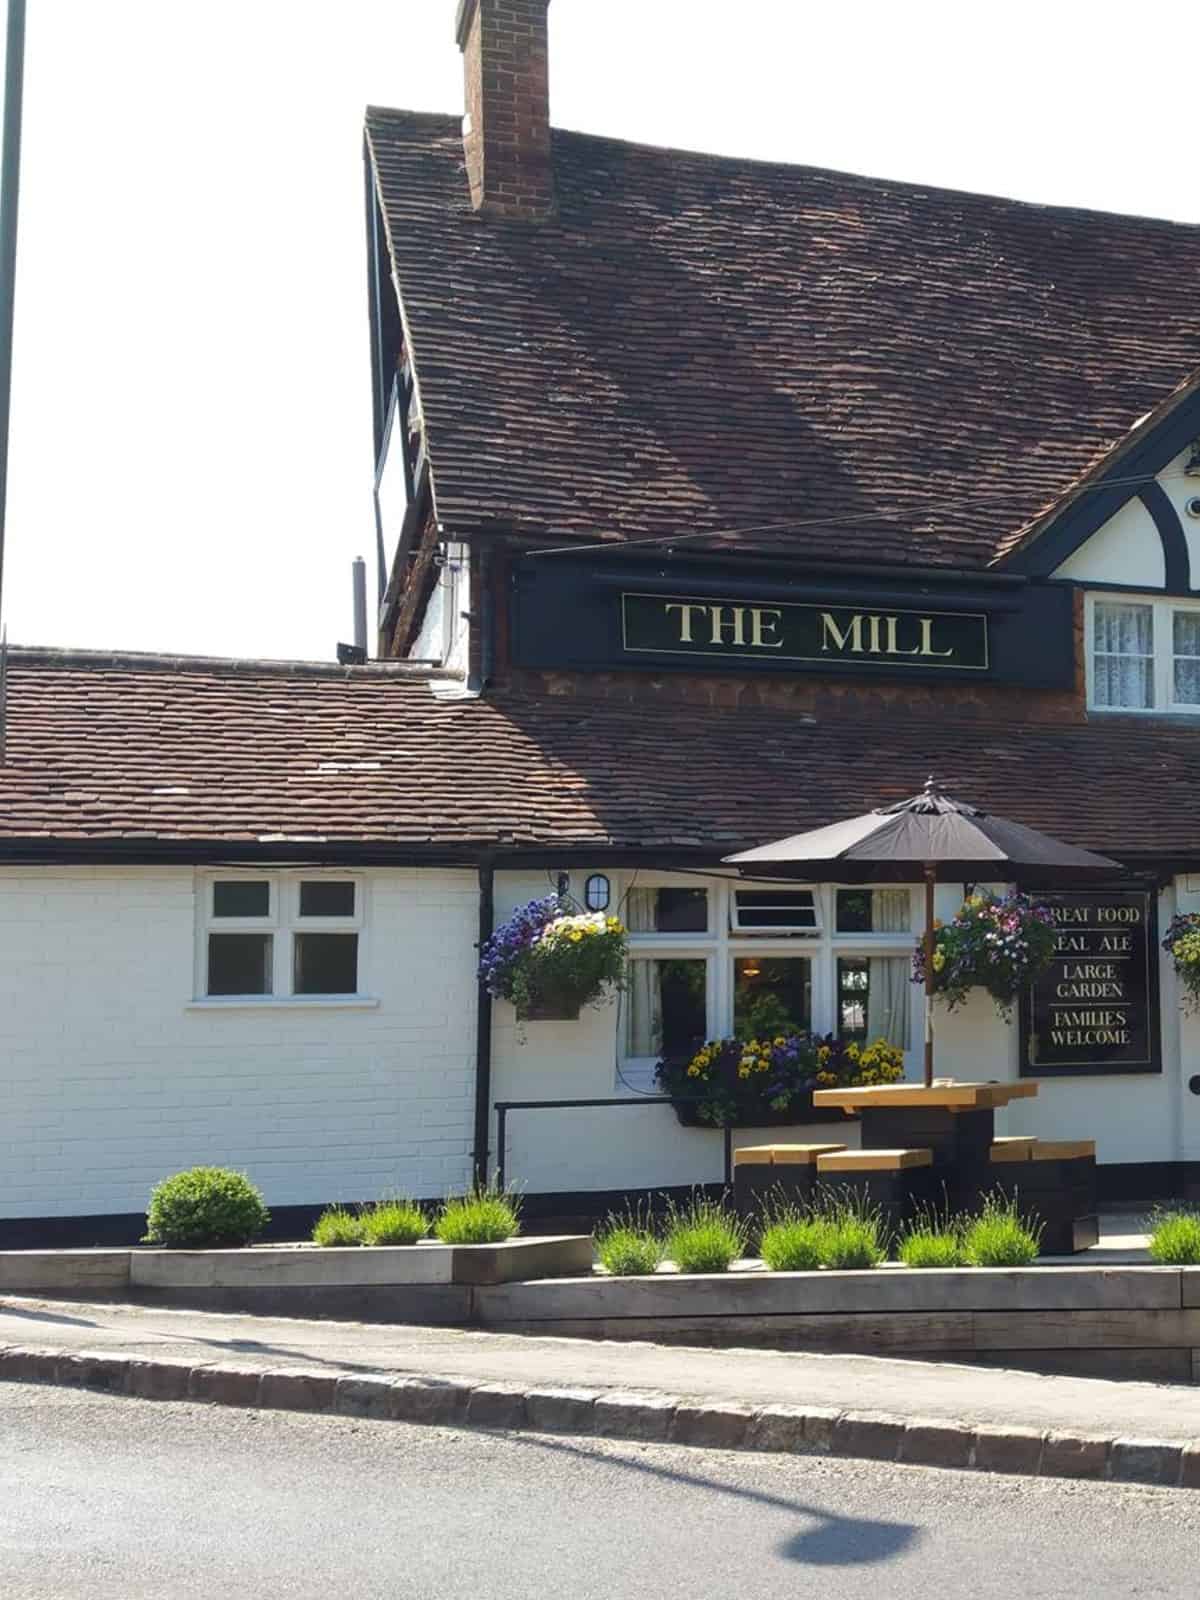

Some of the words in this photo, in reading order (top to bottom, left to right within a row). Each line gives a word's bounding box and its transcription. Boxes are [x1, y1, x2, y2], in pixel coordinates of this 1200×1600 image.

[665, 604, 784, 648] THE
[821, 612, 953, 657] MILL
[1048, 907, 1089, 922] REAT
[1097, 907, 1140, 922] FOOD
[1099, 936, 1132, 951] ALE
[1063, 965, 1116, 980] LARGE
[1056, 983, 1123, 998] GARDEN
[1054, 1011, 1127, 1028] FAMILIES
[1050, 1030, 1131, 1046] WELCOME
